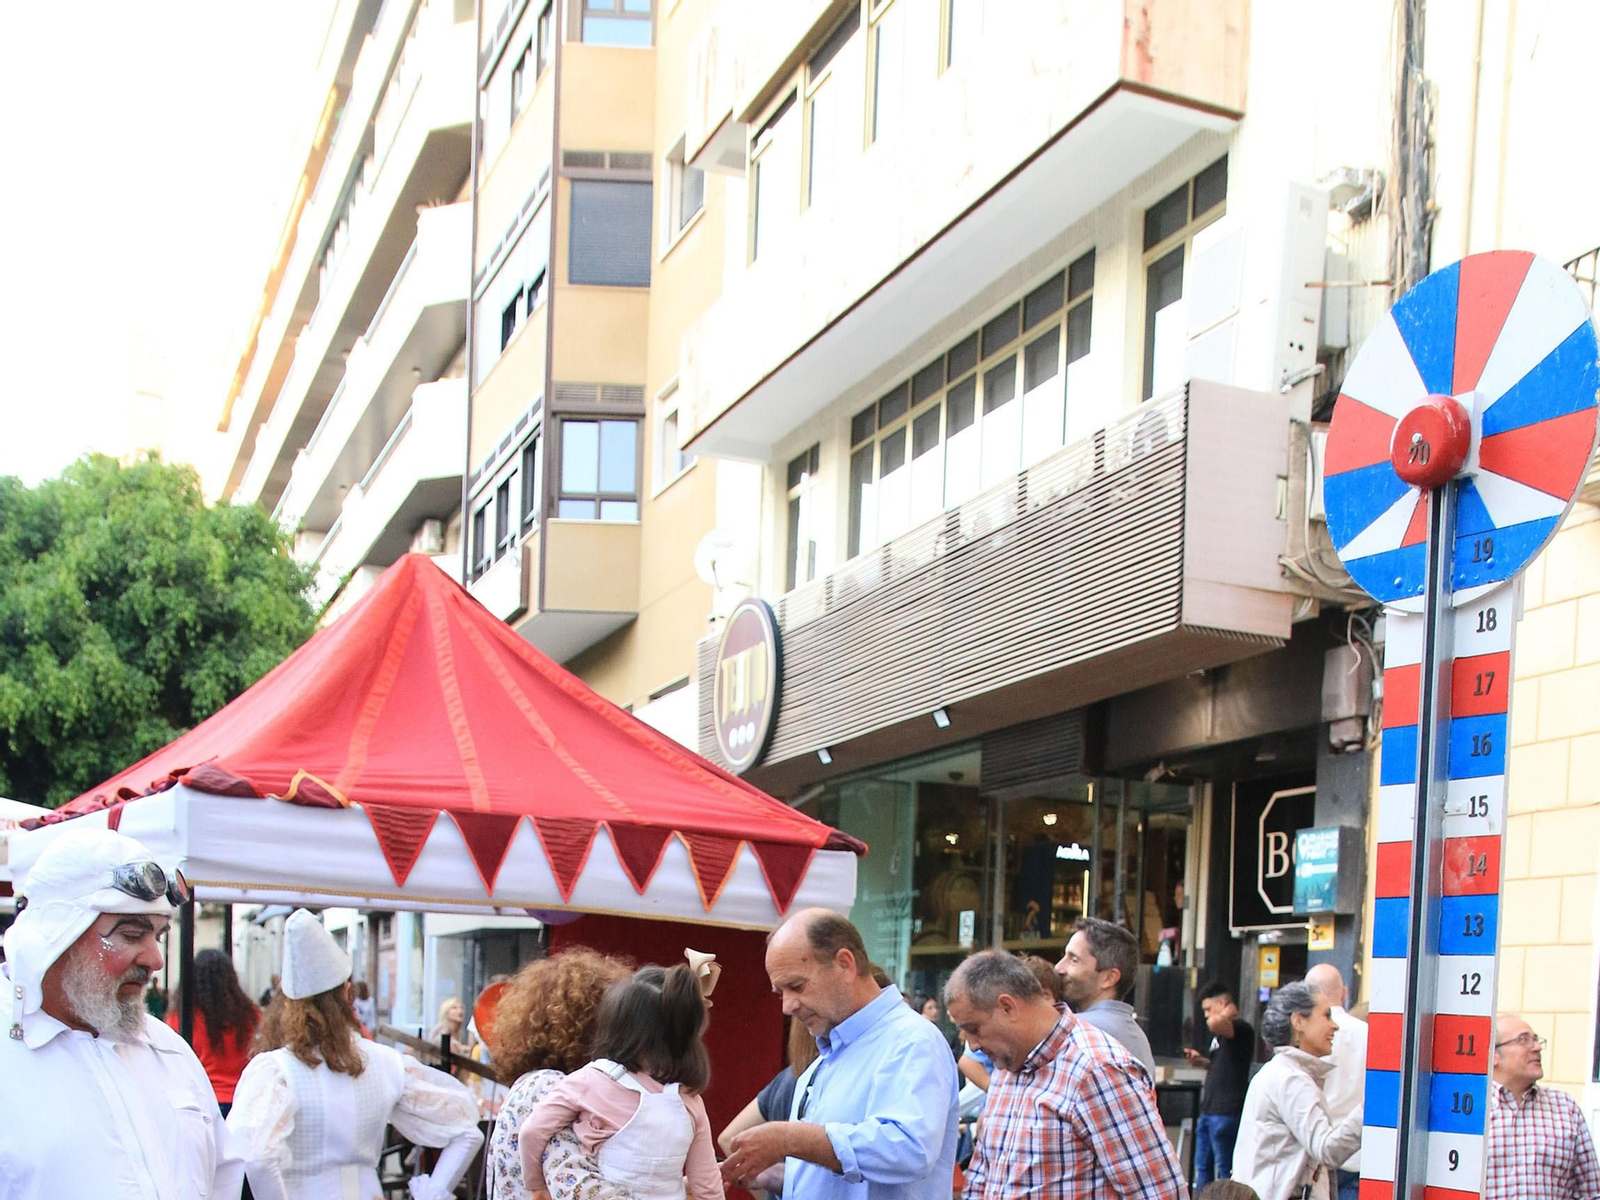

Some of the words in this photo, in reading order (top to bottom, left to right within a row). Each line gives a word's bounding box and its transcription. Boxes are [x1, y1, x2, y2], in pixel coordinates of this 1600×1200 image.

[1407, 441, 1430, 466] 20
[1472, 537, 1493, 563] 19
[1476, 607, 1497, 633] 18
[1473, 671, 1495, 696] 17
[1470, 732, 1492, 757] 16
[1468, 795, 1489, 818] 15
[1467, 853, 1487, 877] 14
[1462, 914, 1484, 936] 13
[1460, 972, 1481, 995] 12
[1455, 1034, 1476, 1056] 11
[1451, 1091, 1474, 1115] 10
[1449, 1149, 1459, 1171] 9
